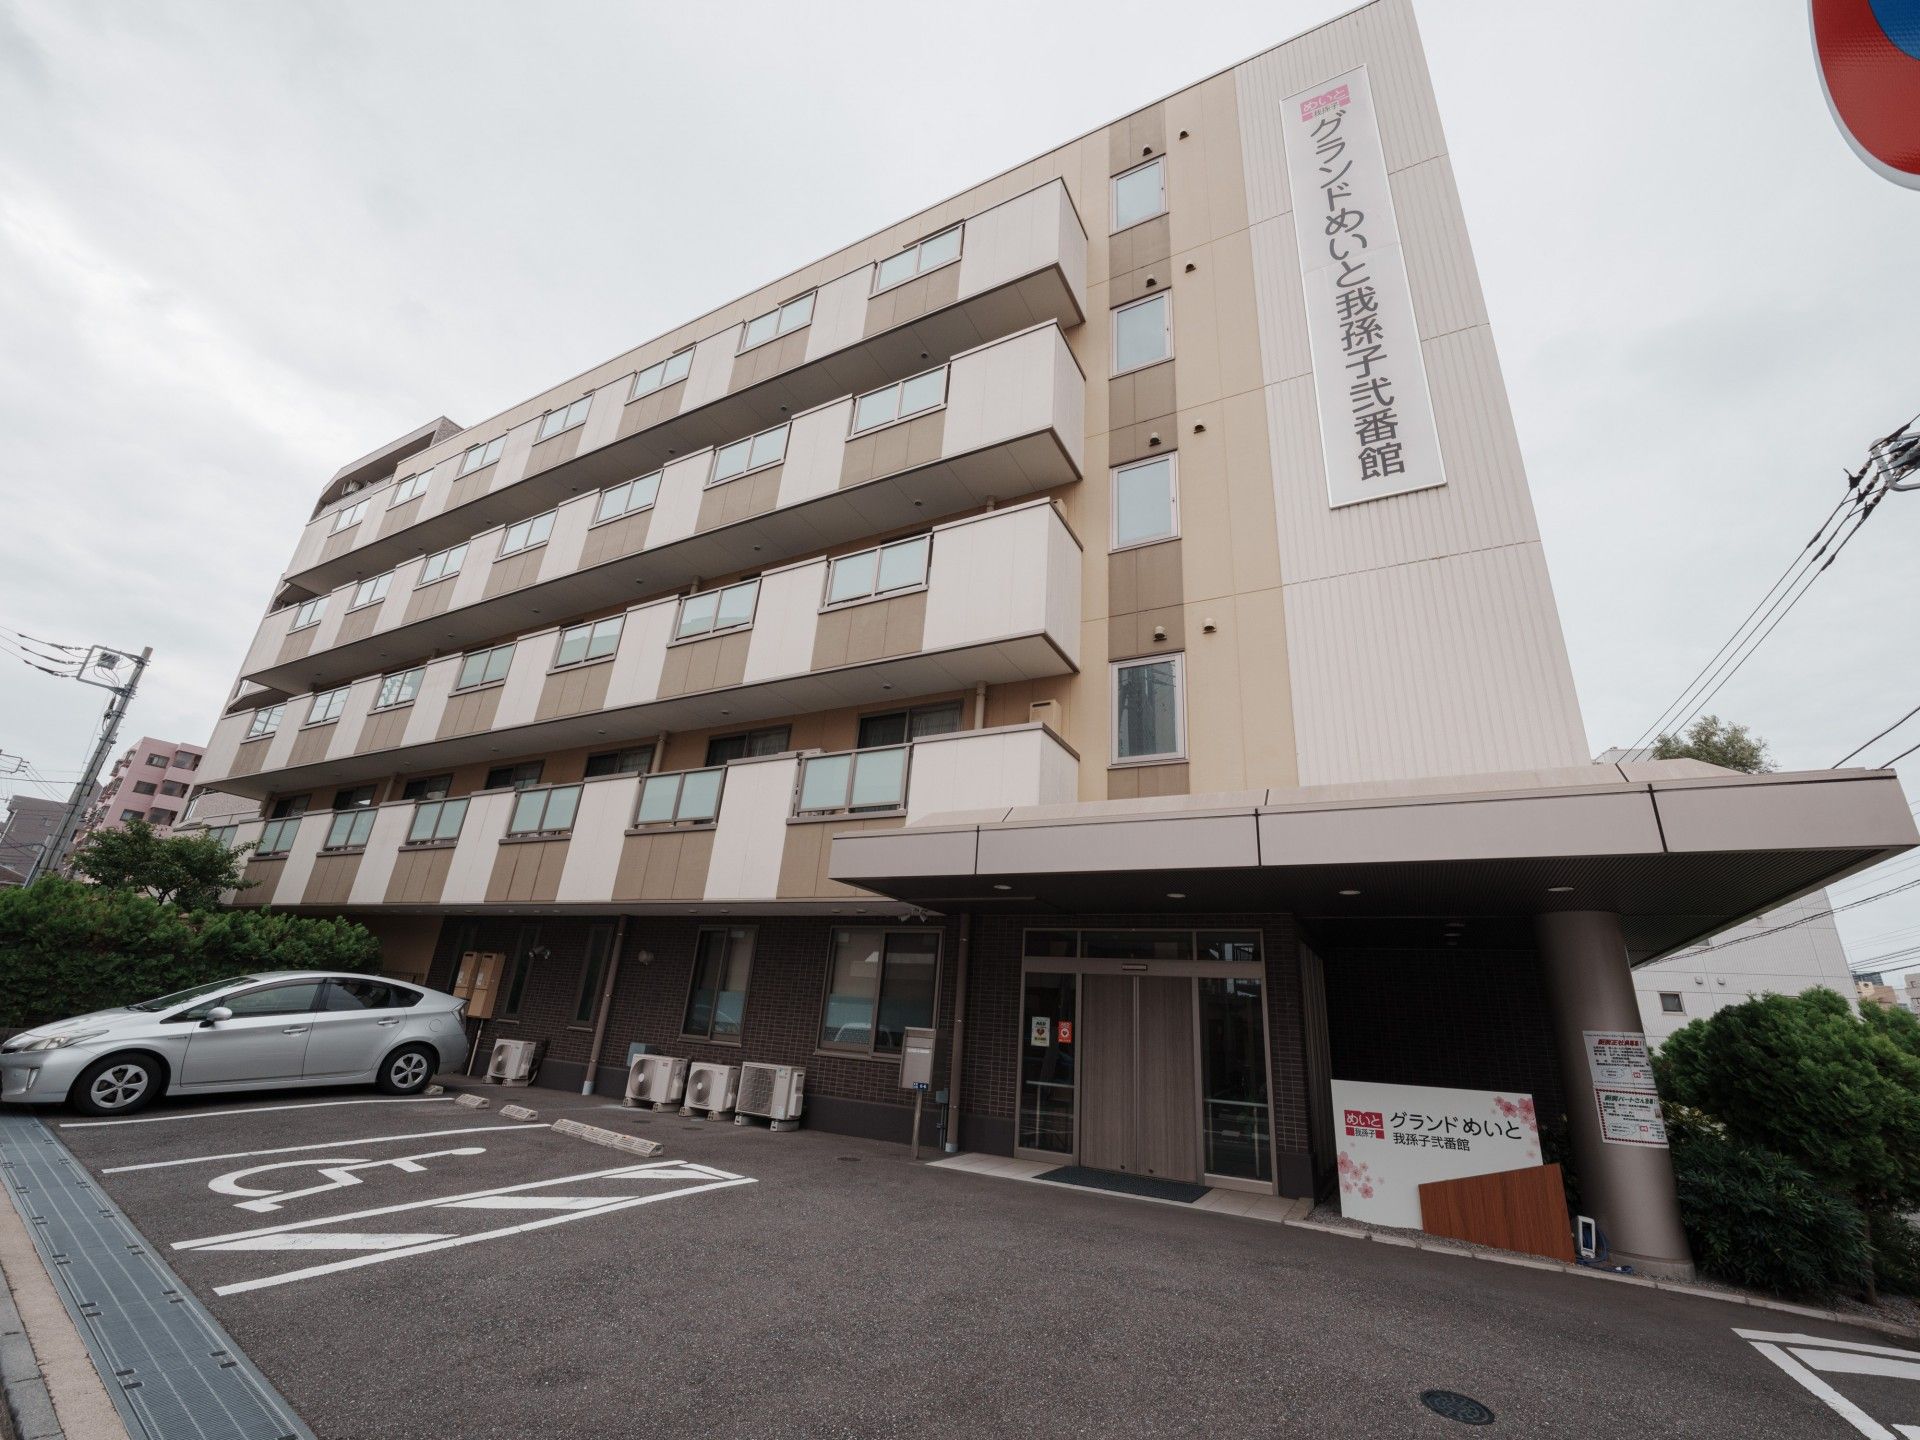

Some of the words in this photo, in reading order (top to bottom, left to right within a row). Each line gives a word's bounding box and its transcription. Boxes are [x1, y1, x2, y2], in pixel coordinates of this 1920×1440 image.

[1303, 89, 1346, 112] めいと
[1310, 109, 1405, 481] グランドめいと我孫子弐番館
[1346, 1113, 1382, 1127] めいと
[1355, 1128, 1375, 1138] 我孫子
[1393, 1131, 1471, 1152] 我孫子弐番館
